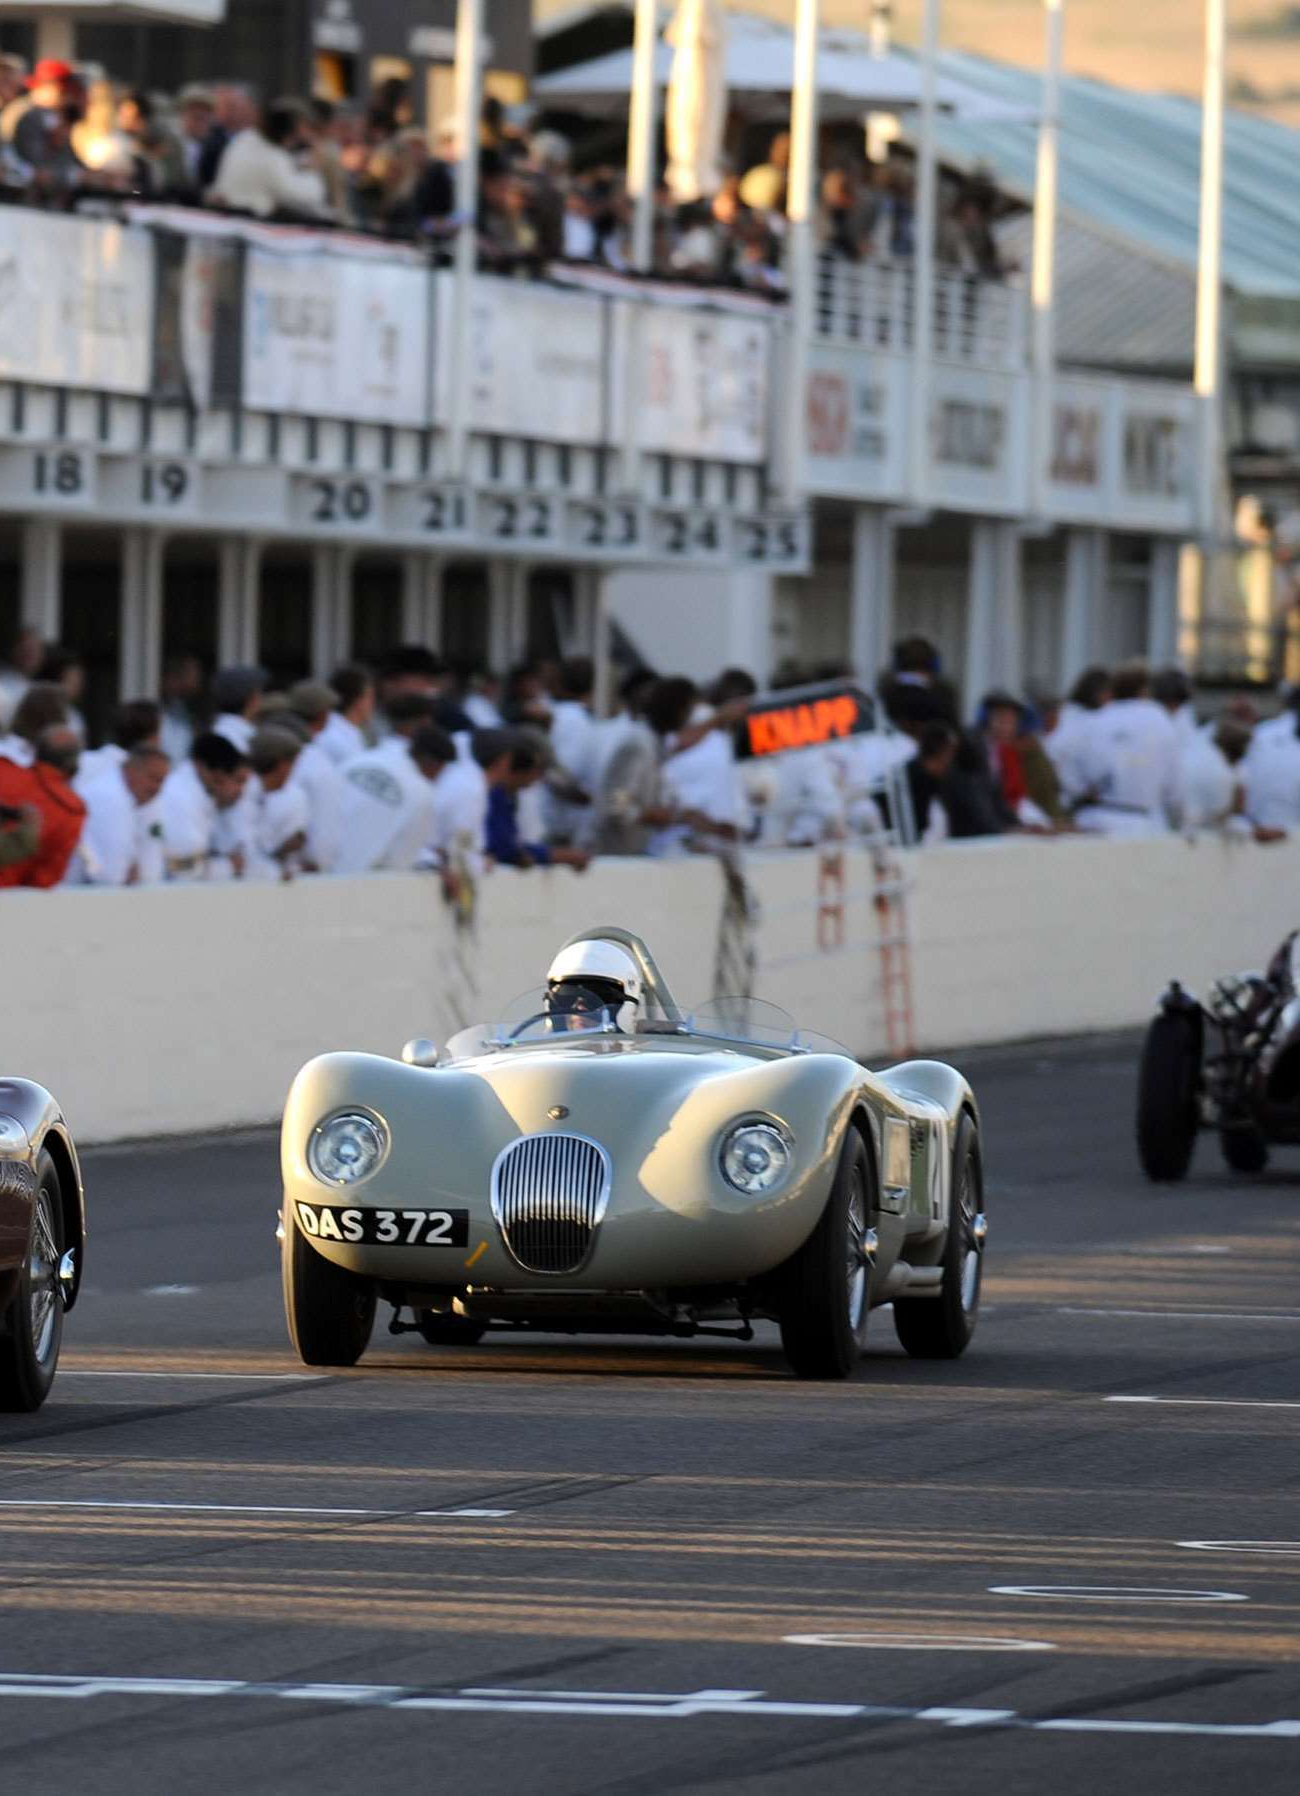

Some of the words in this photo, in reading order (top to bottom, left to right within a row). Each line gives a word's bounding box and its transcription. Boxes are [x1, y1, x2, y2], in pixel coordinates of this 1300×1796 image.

[32, 452, 82, 493] 18
[140, 463, 187, 504] 19
[313, 482, 370, 522] 20
[424, 494, 466, 530] 21
[495, 499, 551, 538] 22
[583, 511, 637, 546] 23
[666, 514, 719, 552] 24
[747, 523, 797, 560] 25
[748, 695, 858, 757] KNAPP
[297, 1202, 365, 1242] DAS
[375, 1211, 453, 1244] 372
